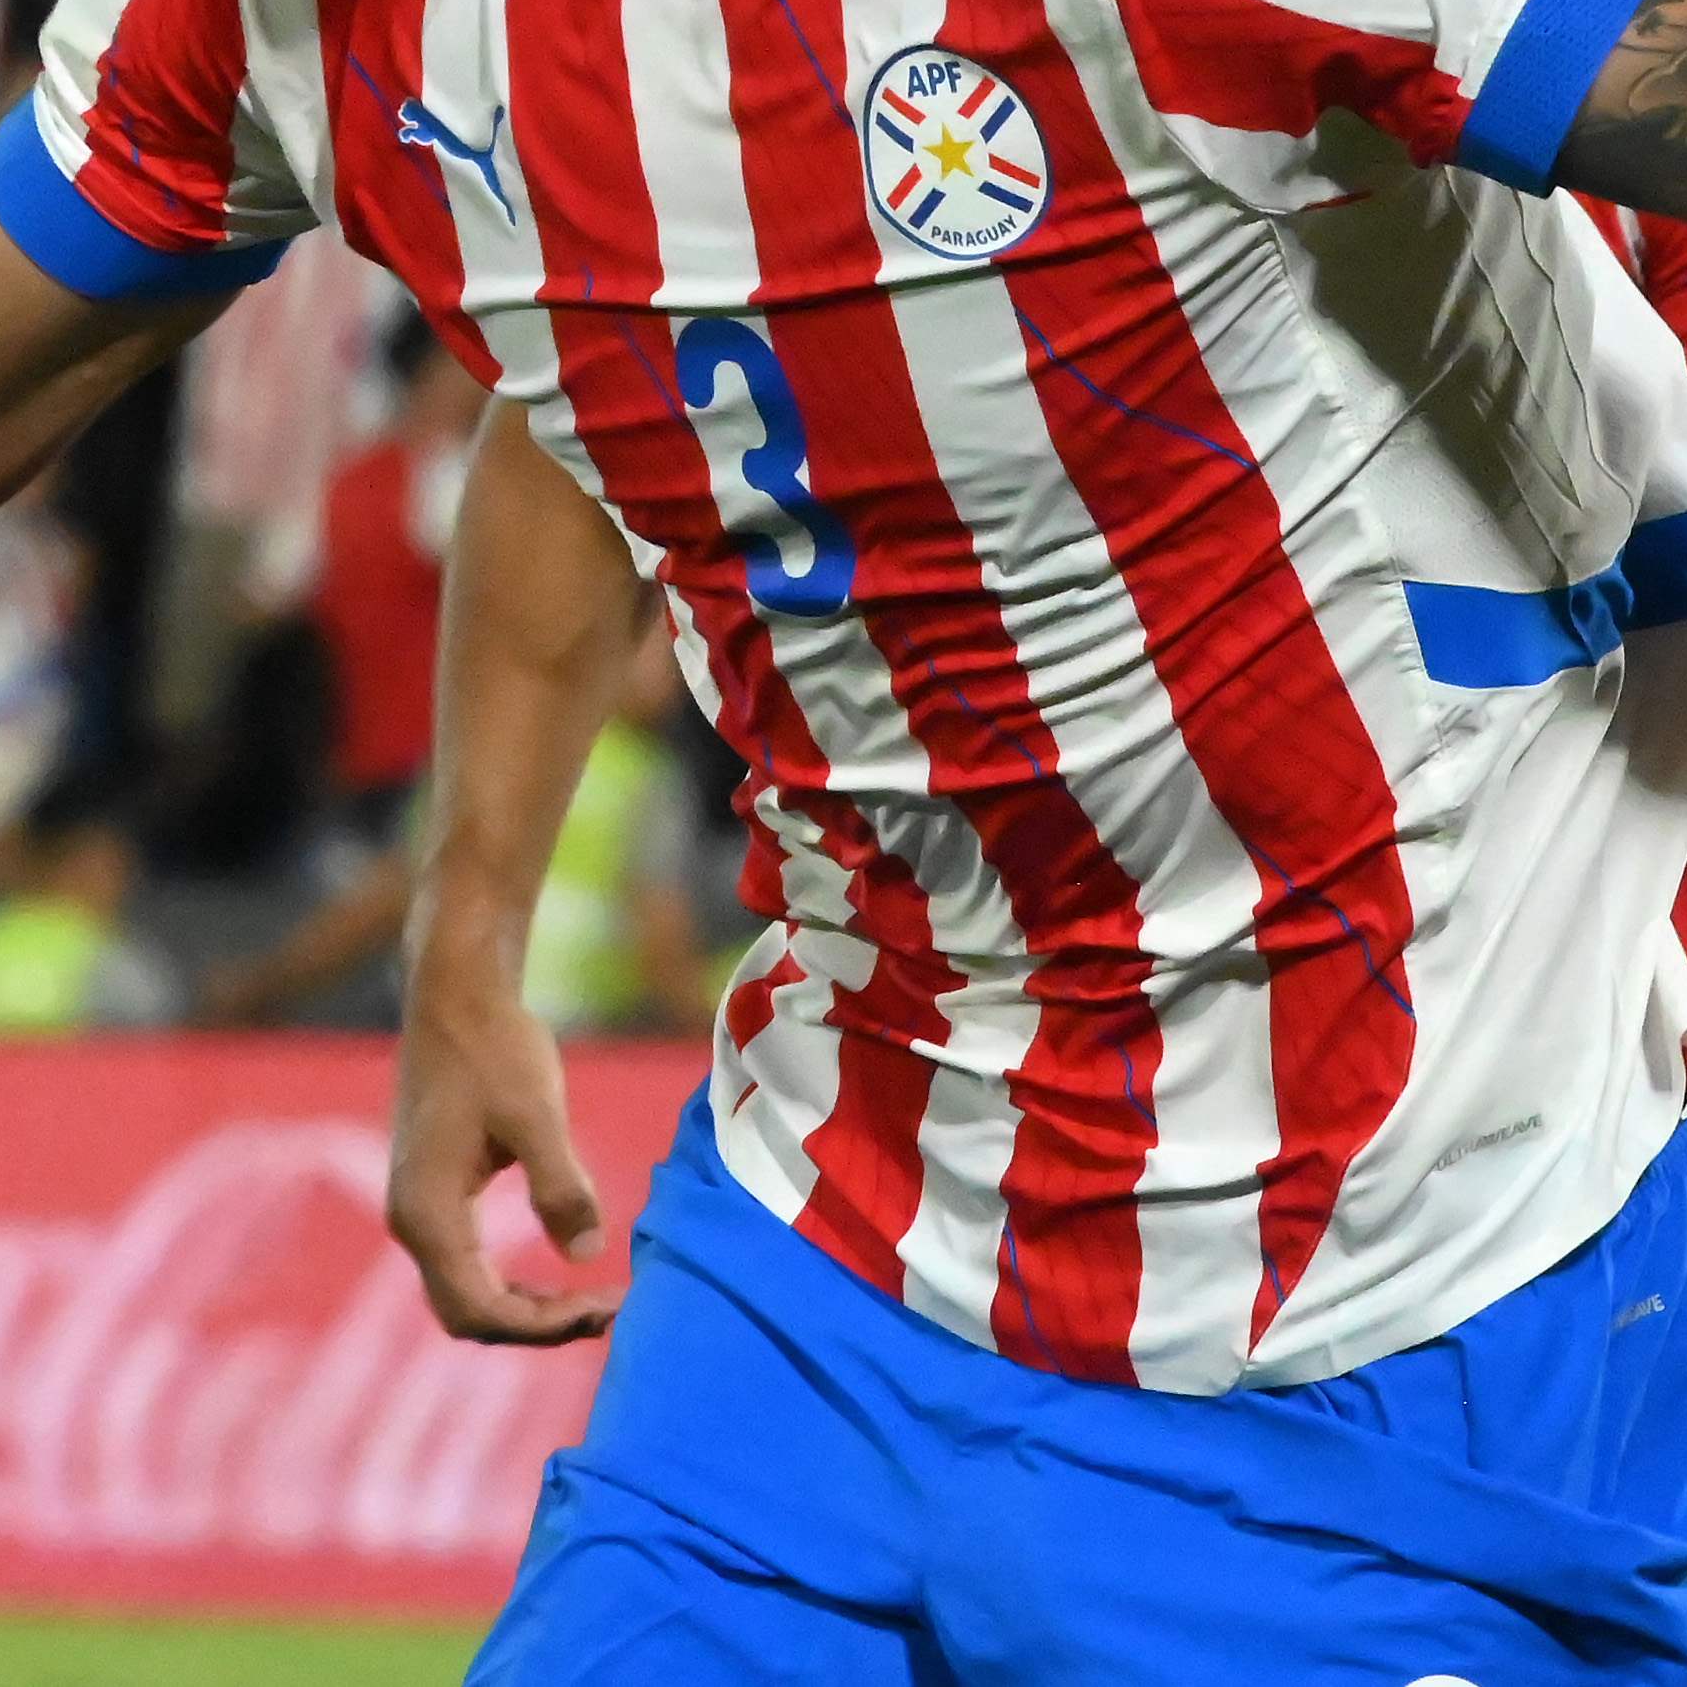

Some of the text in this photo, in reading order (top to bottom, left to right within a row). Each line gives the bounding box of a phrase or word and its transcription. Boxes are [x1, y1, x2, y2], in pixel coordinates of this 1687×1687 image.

[907, 61, 962, 98] APF
[931, 214, 1018, 248] PARAGUAY
[674, 316, 857, 617] 3
